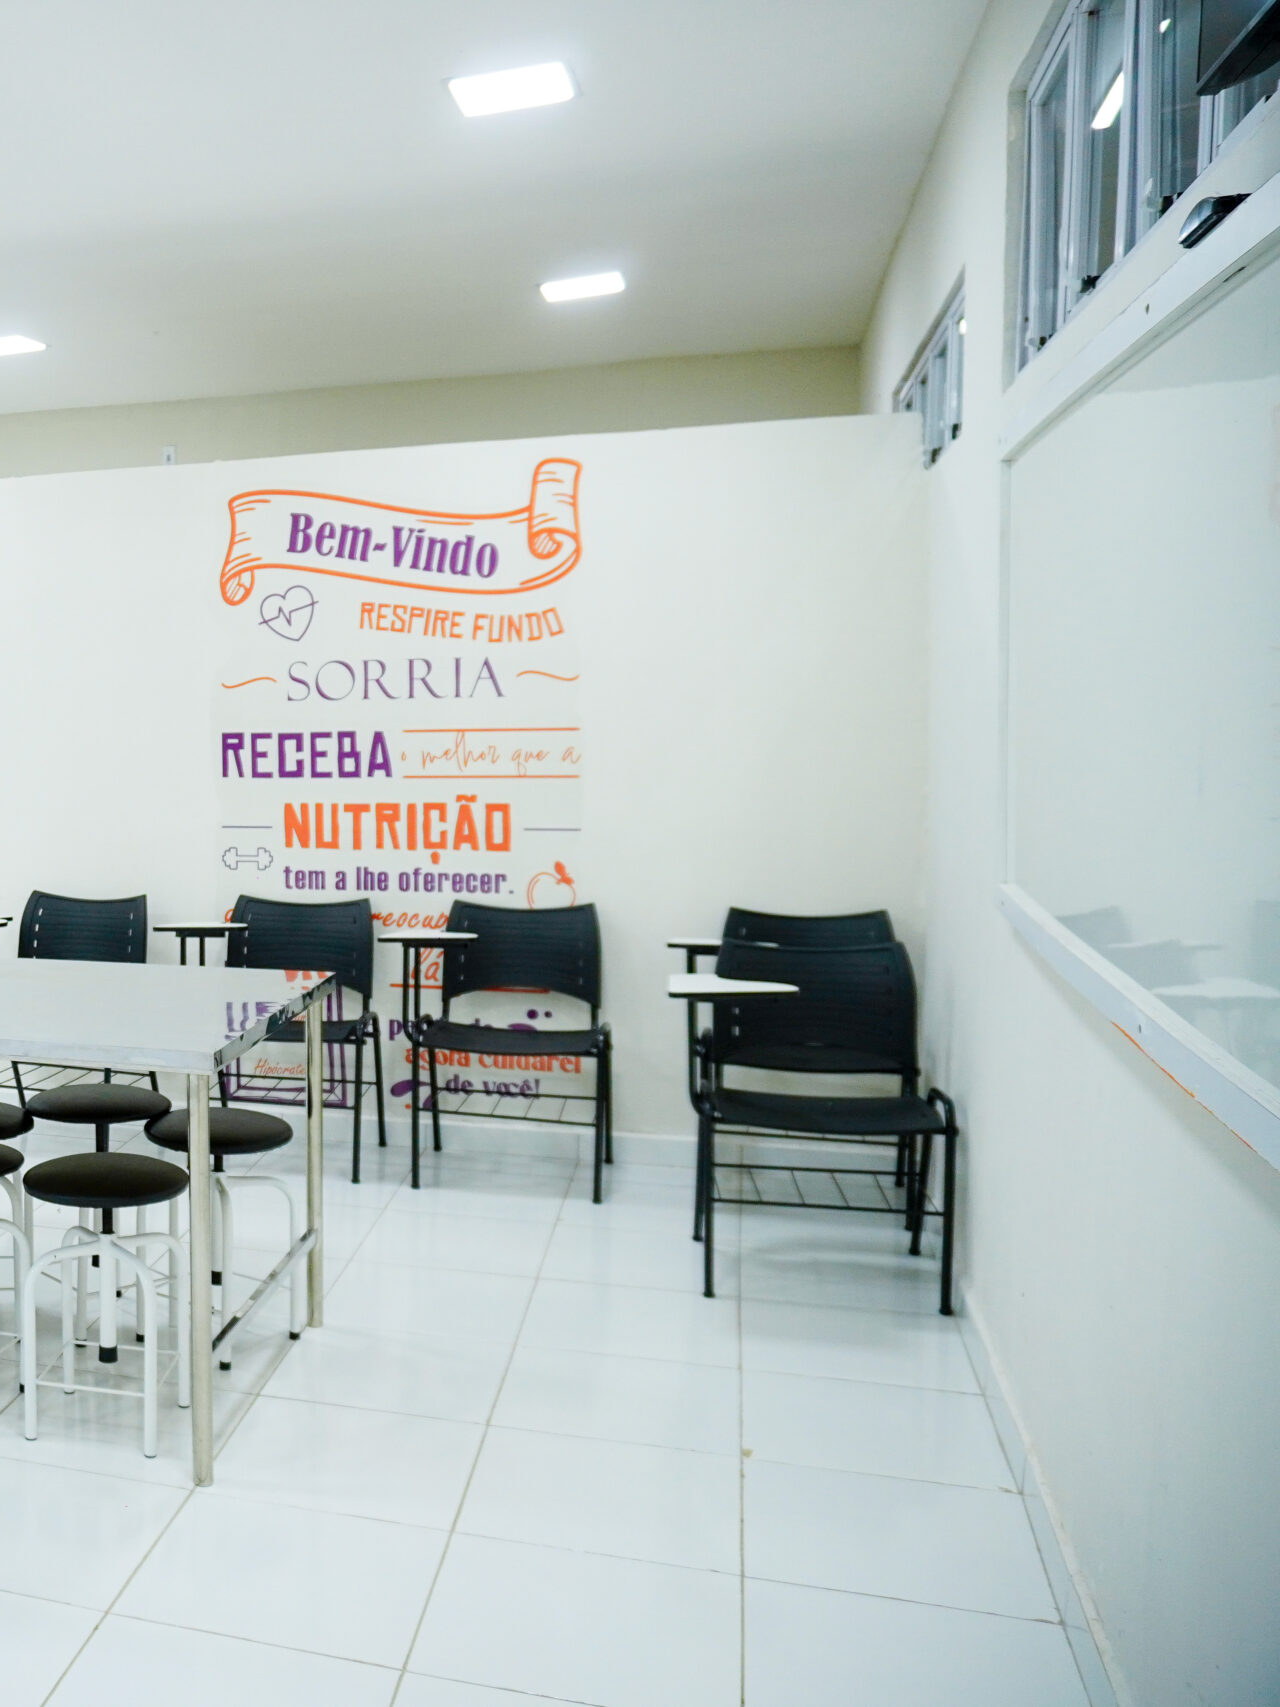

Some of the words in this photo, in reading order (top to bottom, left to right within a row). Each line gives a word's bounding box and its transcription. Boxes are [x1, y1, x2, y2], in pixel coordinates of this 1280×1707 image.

[287, 512, 499, 579] Bem-Vindo
[360, 601, 465, 639] RESPIRE
[472, 607, 564, 643] FUNDO
[287, 657, 505, 702] SORRIA
[221, 731, 393, 779] RECEBA
[421, 731, 500, 771] melhor
[511, 749, 549, 775] que
[561, 746, 581, 764] a
[283, 794, 512, 864] NUTRIÇÃO
[284, 866, 326, 890] tem
[335, 871, 347, 890] a
[356, 867, 390, 891] lhe
[398, 866, 515, 894] oferecer.
